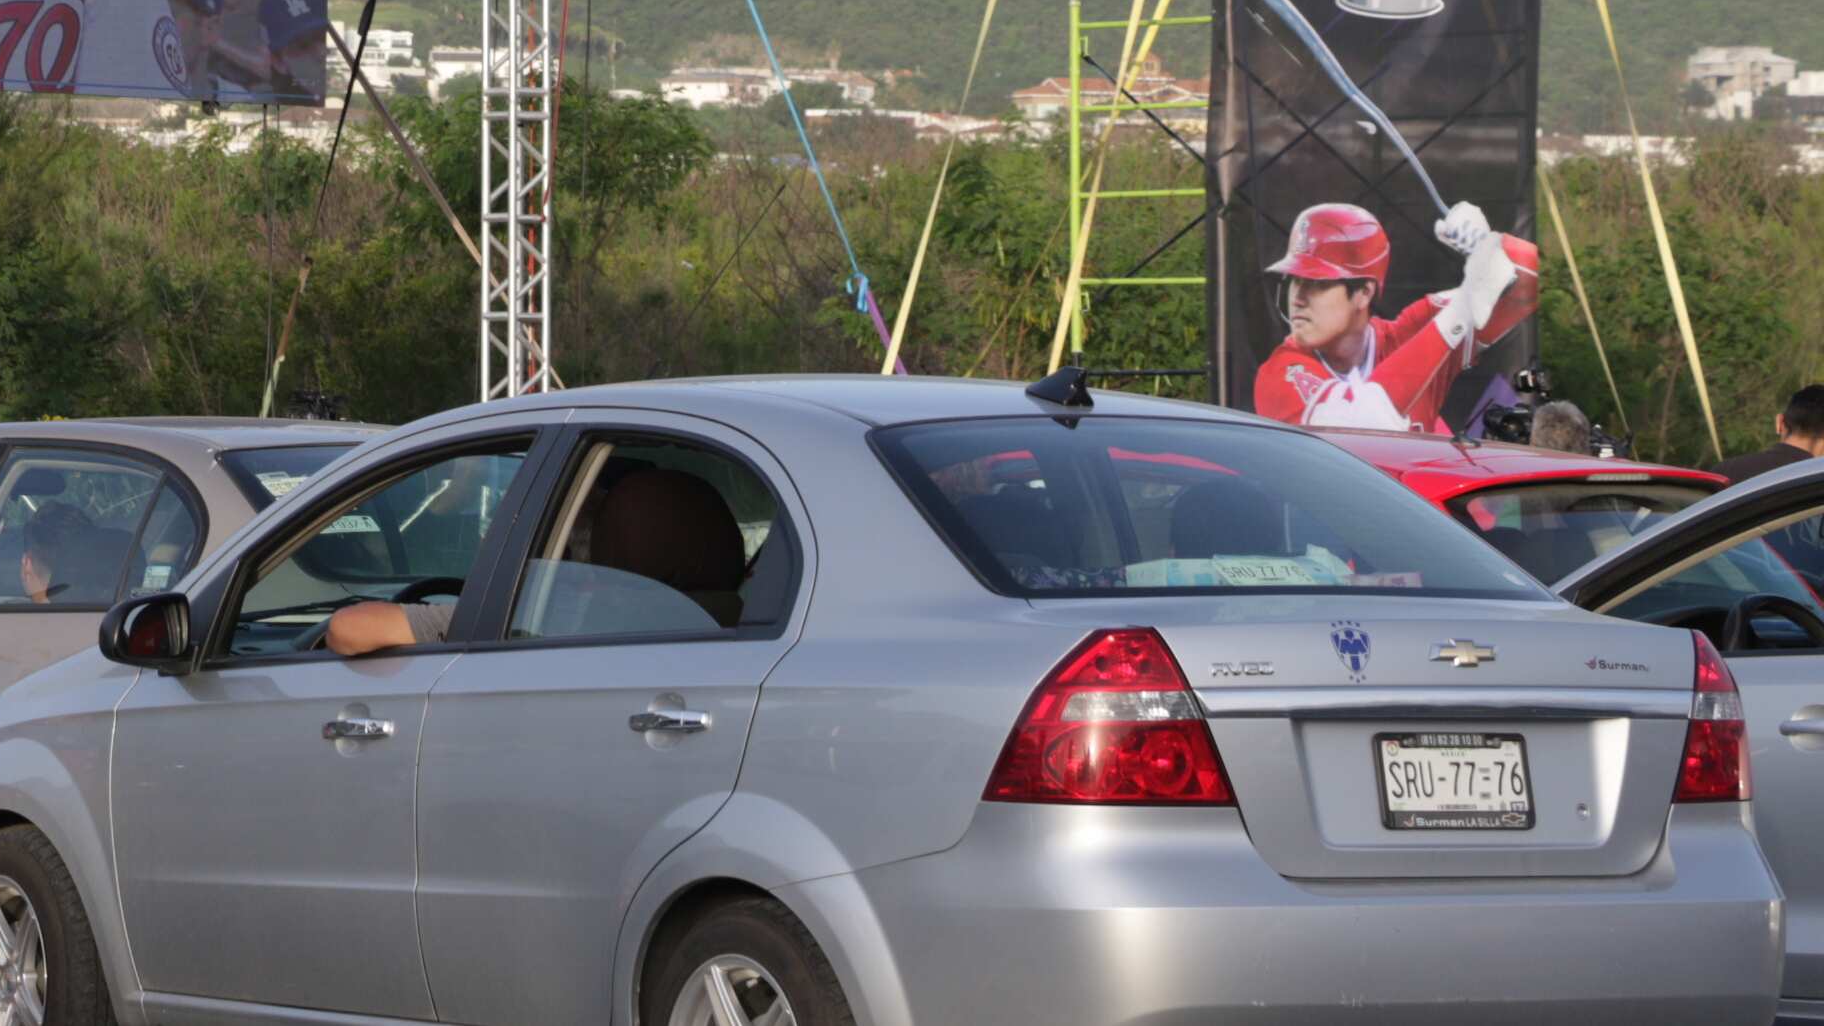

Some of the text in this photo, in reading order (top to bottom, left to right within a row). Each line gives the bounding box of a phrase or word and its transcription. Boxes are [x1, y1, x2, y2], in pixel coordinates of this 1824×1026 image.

[1211, 661, 1275, 676] AVEO
[1388, 760, 1525, 799] SRU-77-76
[1416, 817, 1465, 827] Surman
